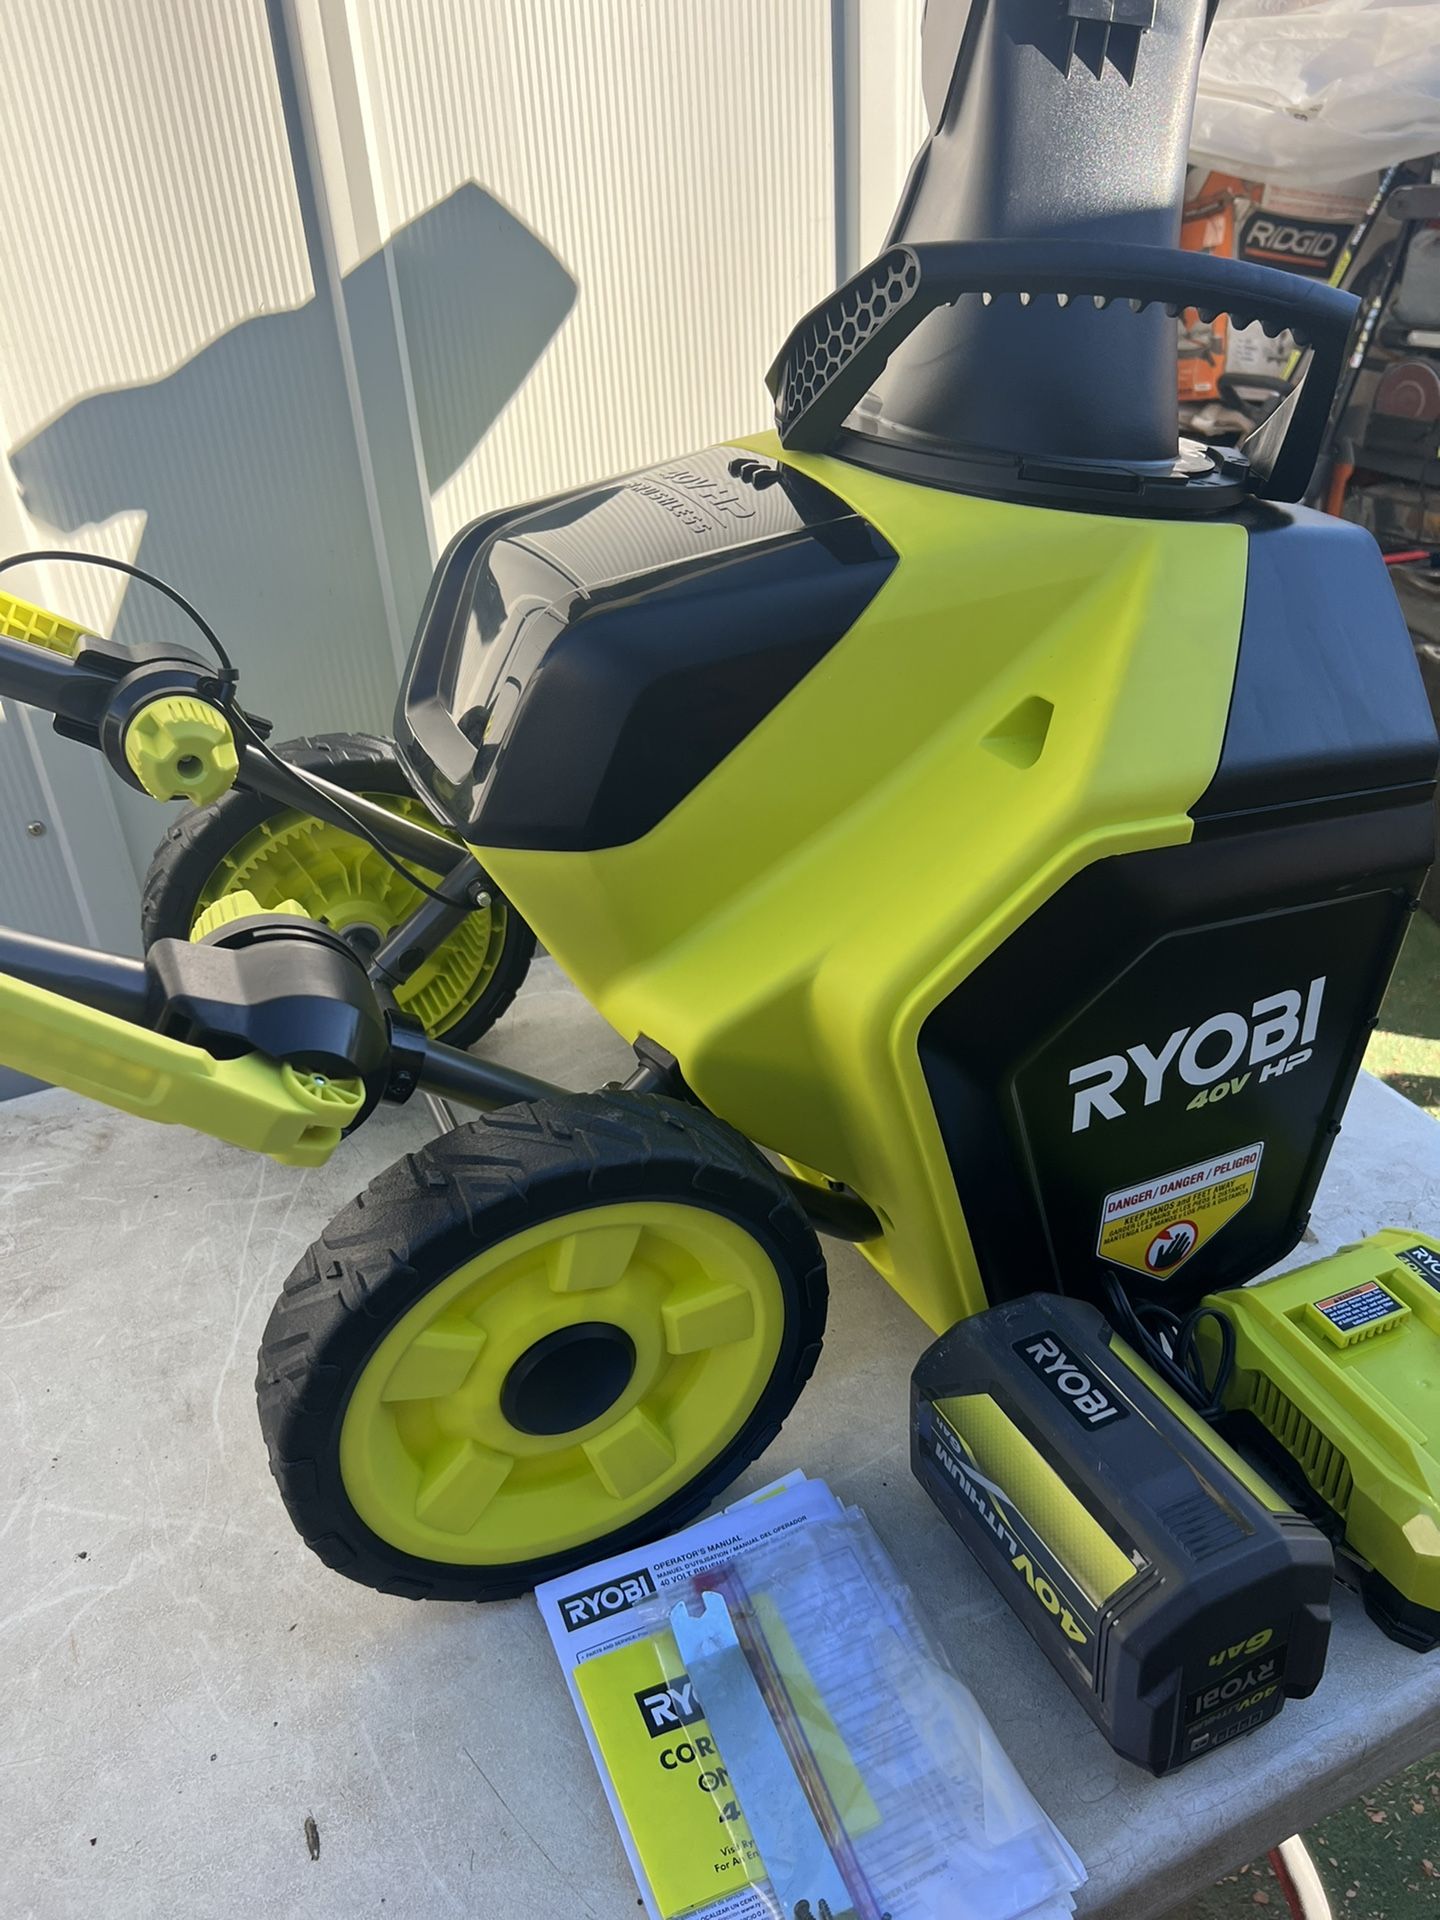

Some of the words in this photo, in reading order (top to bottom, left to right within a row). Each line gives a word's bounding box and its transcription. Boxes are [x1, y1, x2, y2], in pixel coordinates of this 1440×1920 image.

[1246, 220, 1338, 257] RIDGID
[625, 482, 713, 534] BRUSHLESS
[1068, 975, 1327, 1134] RYOBI
[1185, 1071, 1252, 1111] 40V
[1258, 1047, 1313, 1084] HP
[1107, 1188, 1153, 1213] DANGER
[1159, 1170, 1205, 1196] DANGER
[1213, 1152, 1258, 1177] PELIGRO
[1124, 1211, 1146, 1226] KEEP
[1146, 1201, 1175, 1217] HANDS
[1025, 1337, 1118, 1423] RYOBI
[935, 1442, 1018, 1556] LITHIUM
[653, 1546, 706, 1571] OPERATOR'S
[707, 1534, 743, 1553] MANUAL
[656, 1565, 684, 1580] MANUEL
[733, 1537, 760, 1553] MANUAL
[760, 1531, 773, 1541] DEL
[773, 1514, 808, 1534] OPERADOR
[564, 1574, 650, 1625] RYOBI
[660, 1578, 671, 1588] 40
[671, 1571, 692, 1584] VOLT
[1011, 1554, 1088, 1645] 40V
[643, 1682, 700, 1727] RY
[1195, 1659, 1275, 1715] RYOBI
[660, 1735, 716, 1770] COR
[714, 1862, 730, 1873] For
